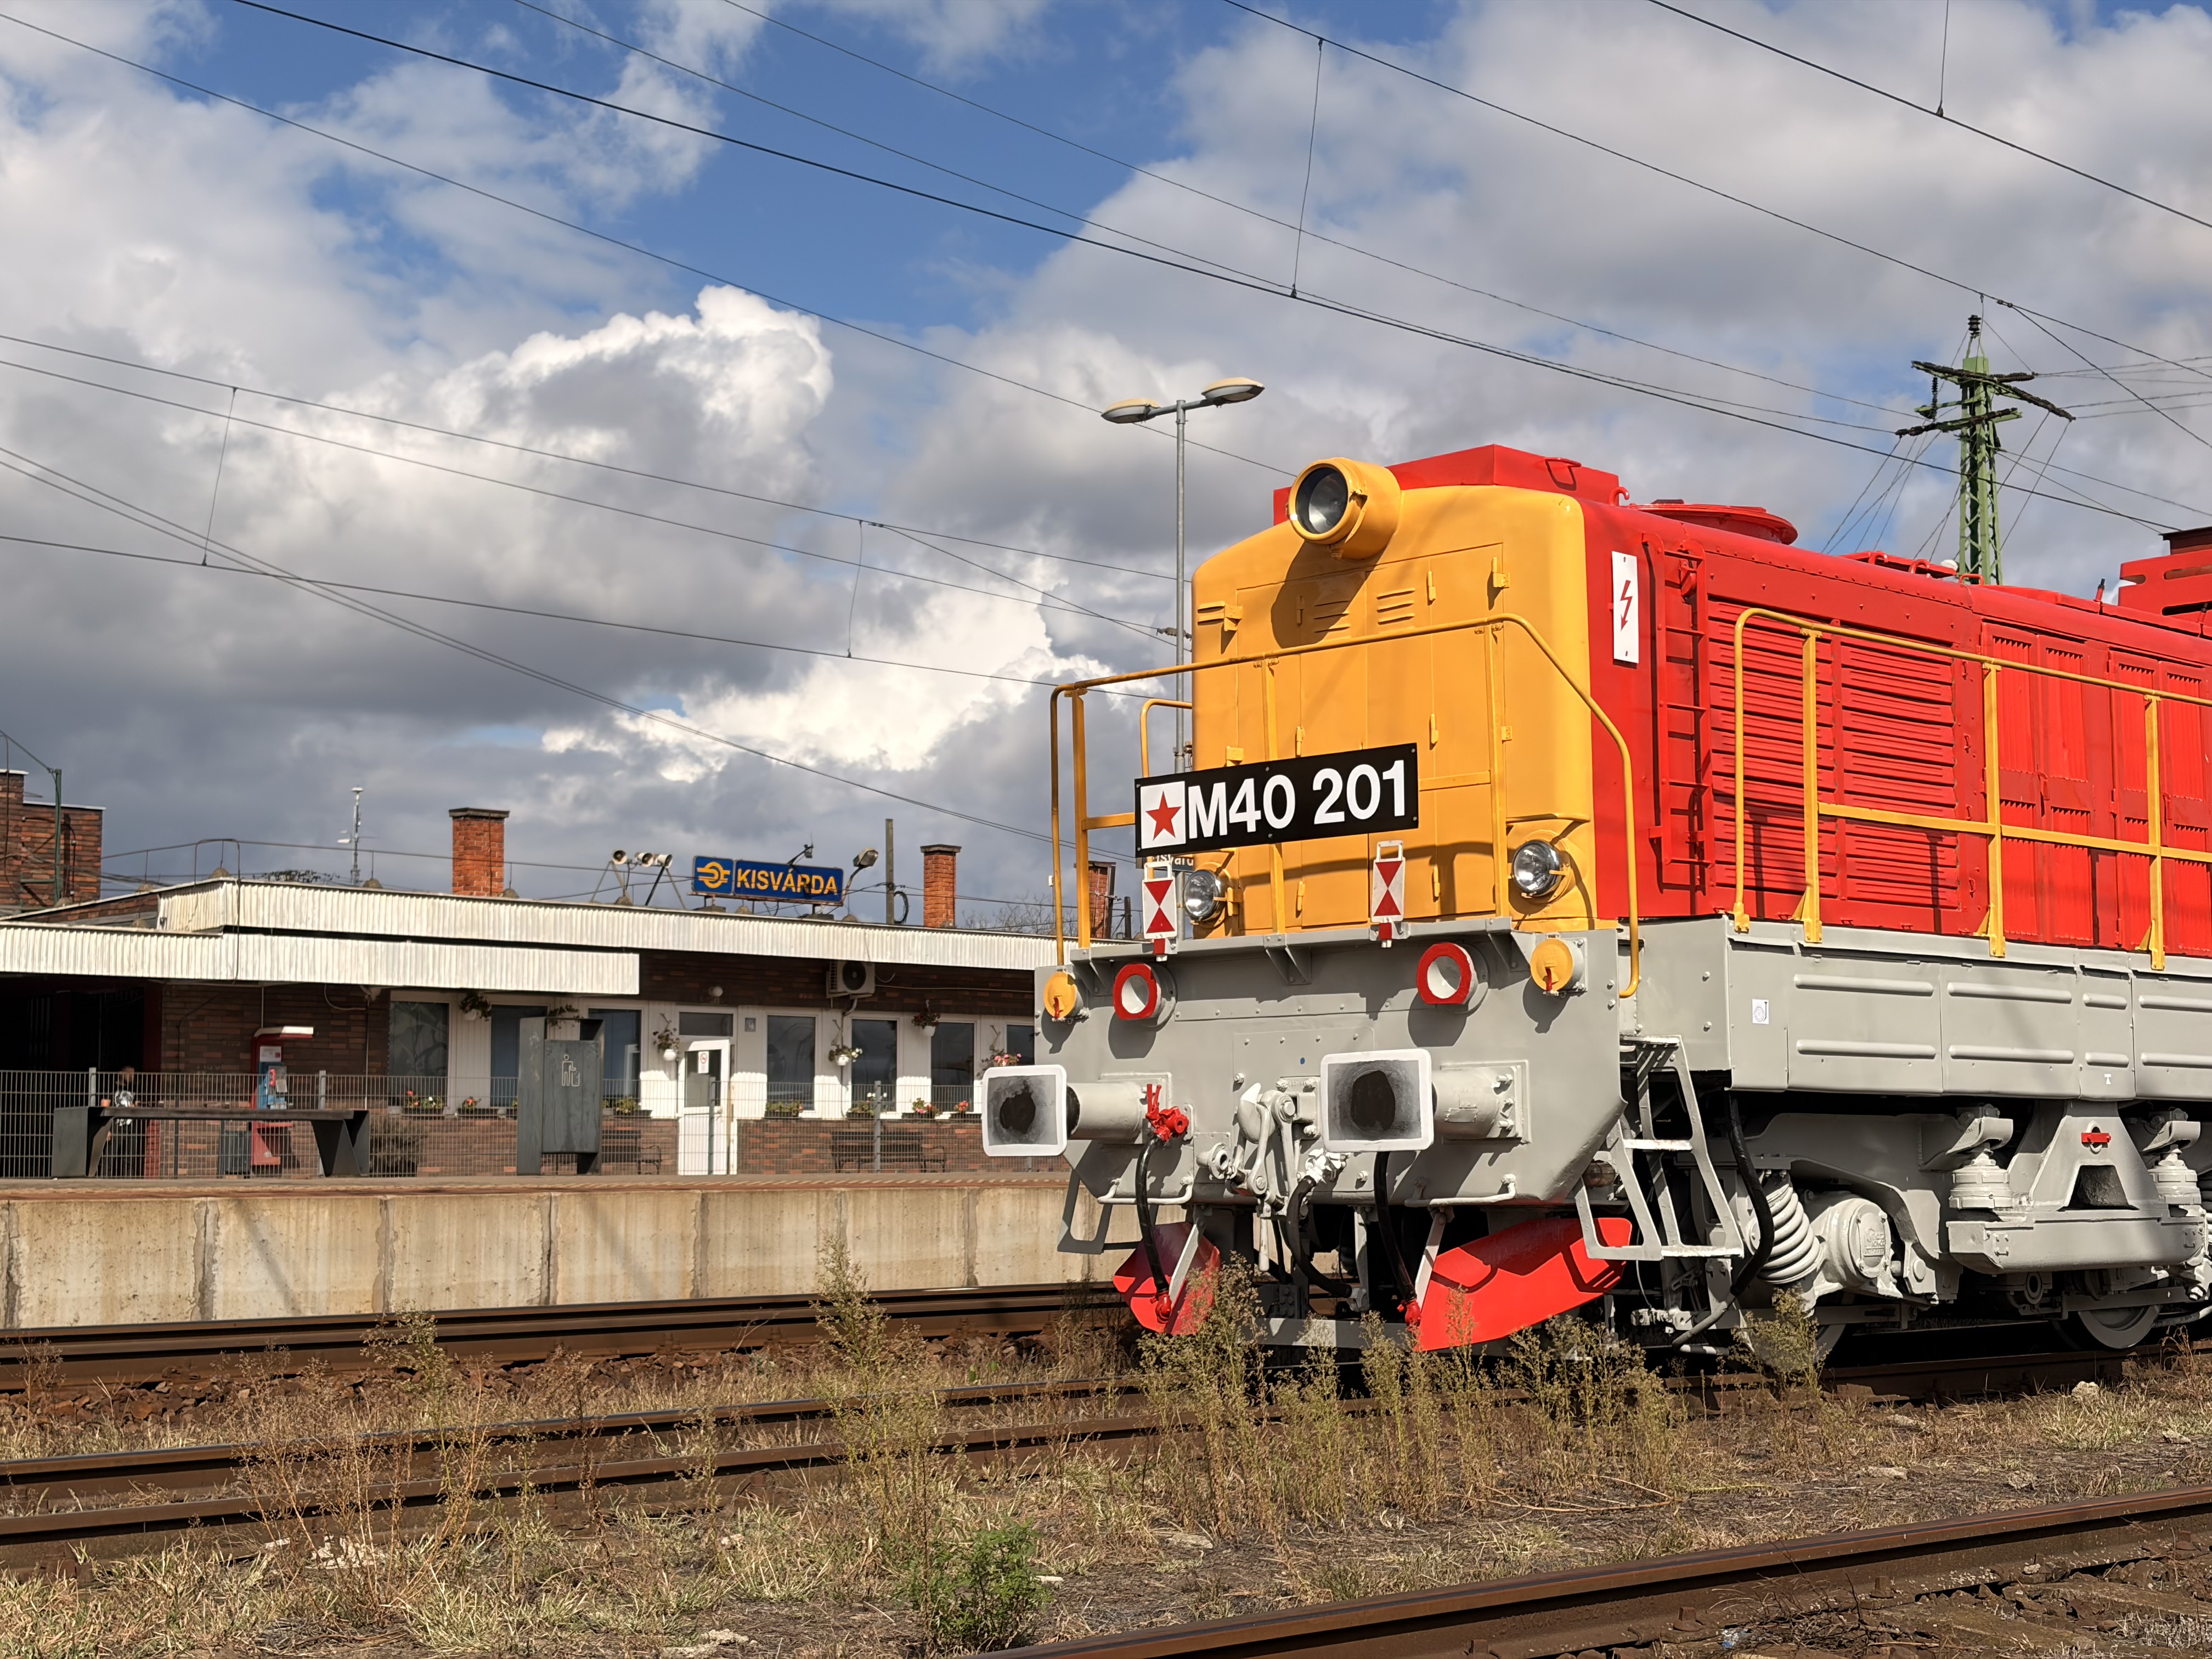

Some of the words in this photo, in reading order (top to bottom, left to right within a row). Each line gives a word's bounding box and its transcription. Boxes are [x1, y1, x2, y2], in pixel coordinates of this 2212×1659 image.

[1188, 775, 1296, 839] M40
[1312, 759, 1405, 825] 201
[737, 868, 838, 895] KISVÁRDA
